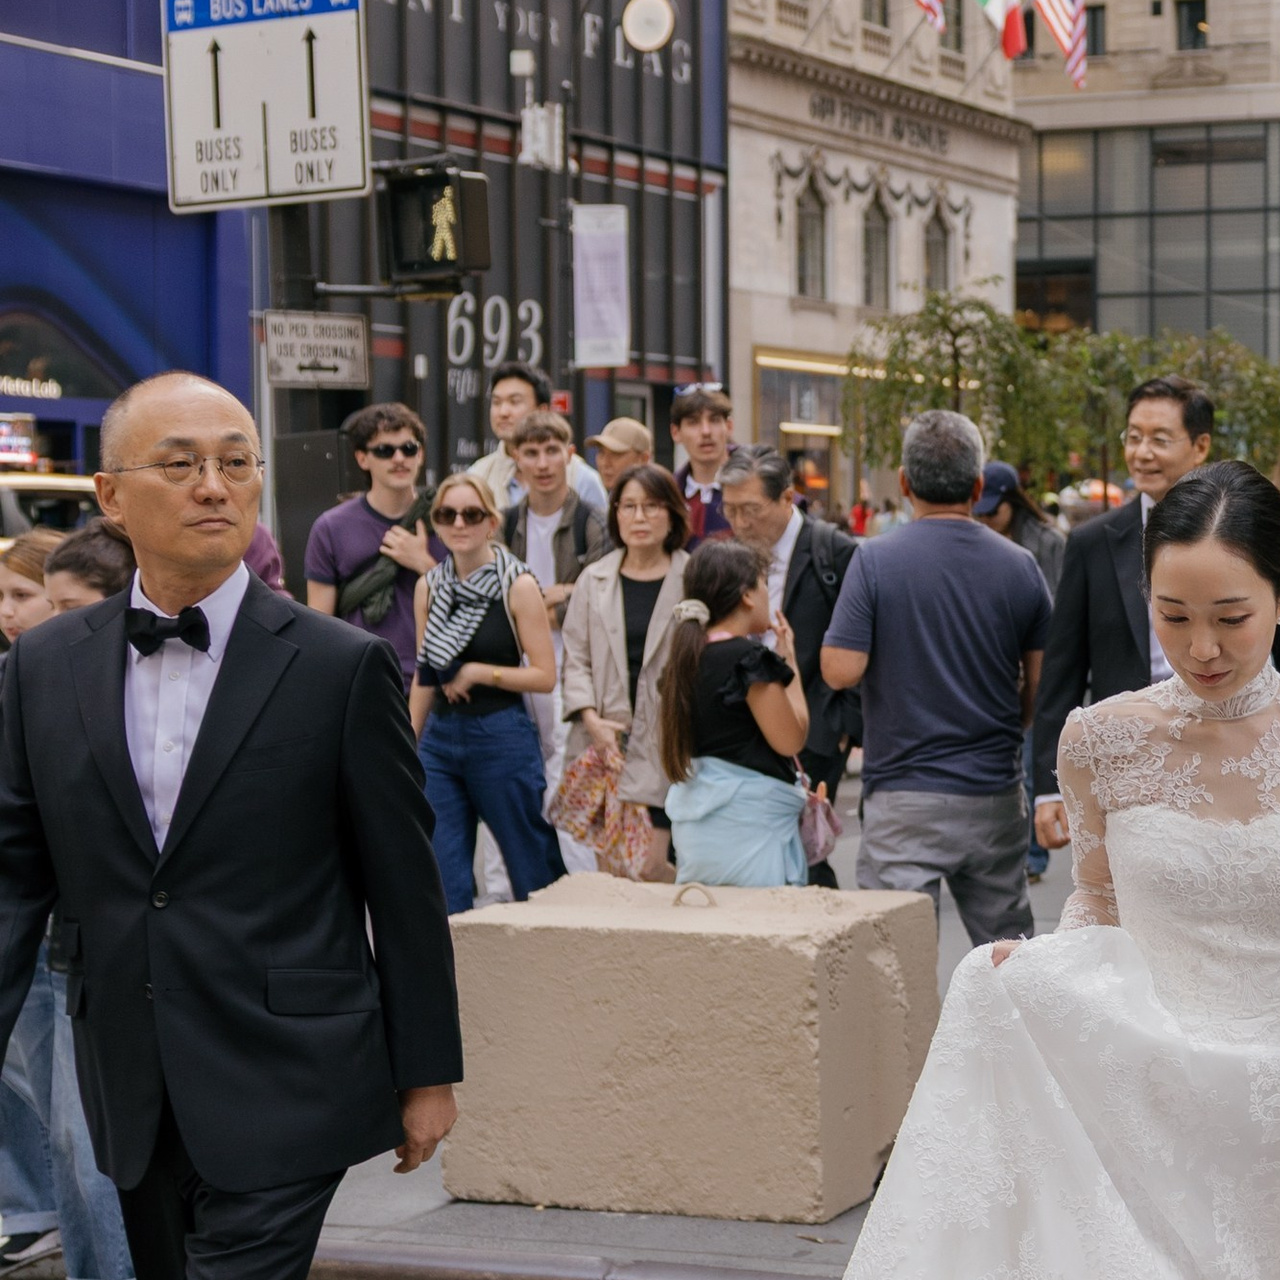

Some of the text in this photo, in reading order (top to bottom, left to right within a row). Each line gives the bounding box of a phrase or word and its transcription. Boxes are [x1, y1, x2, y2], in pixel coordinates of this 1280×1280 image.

[195, 136, 241, 164] BUSES
[289, 125, 337, 154] BUSES
[200, 169, 239, 194] ONLY
[295, 158, 334, 185] ONLY
[270, 322, 284, 337] NO
[313, 323, 360, 340] CROSSING
[446, 290, 543, 368] 693
[276, 342, 357, 360] USE CROSSWALK
[32, 377, 62, 399] Lab
